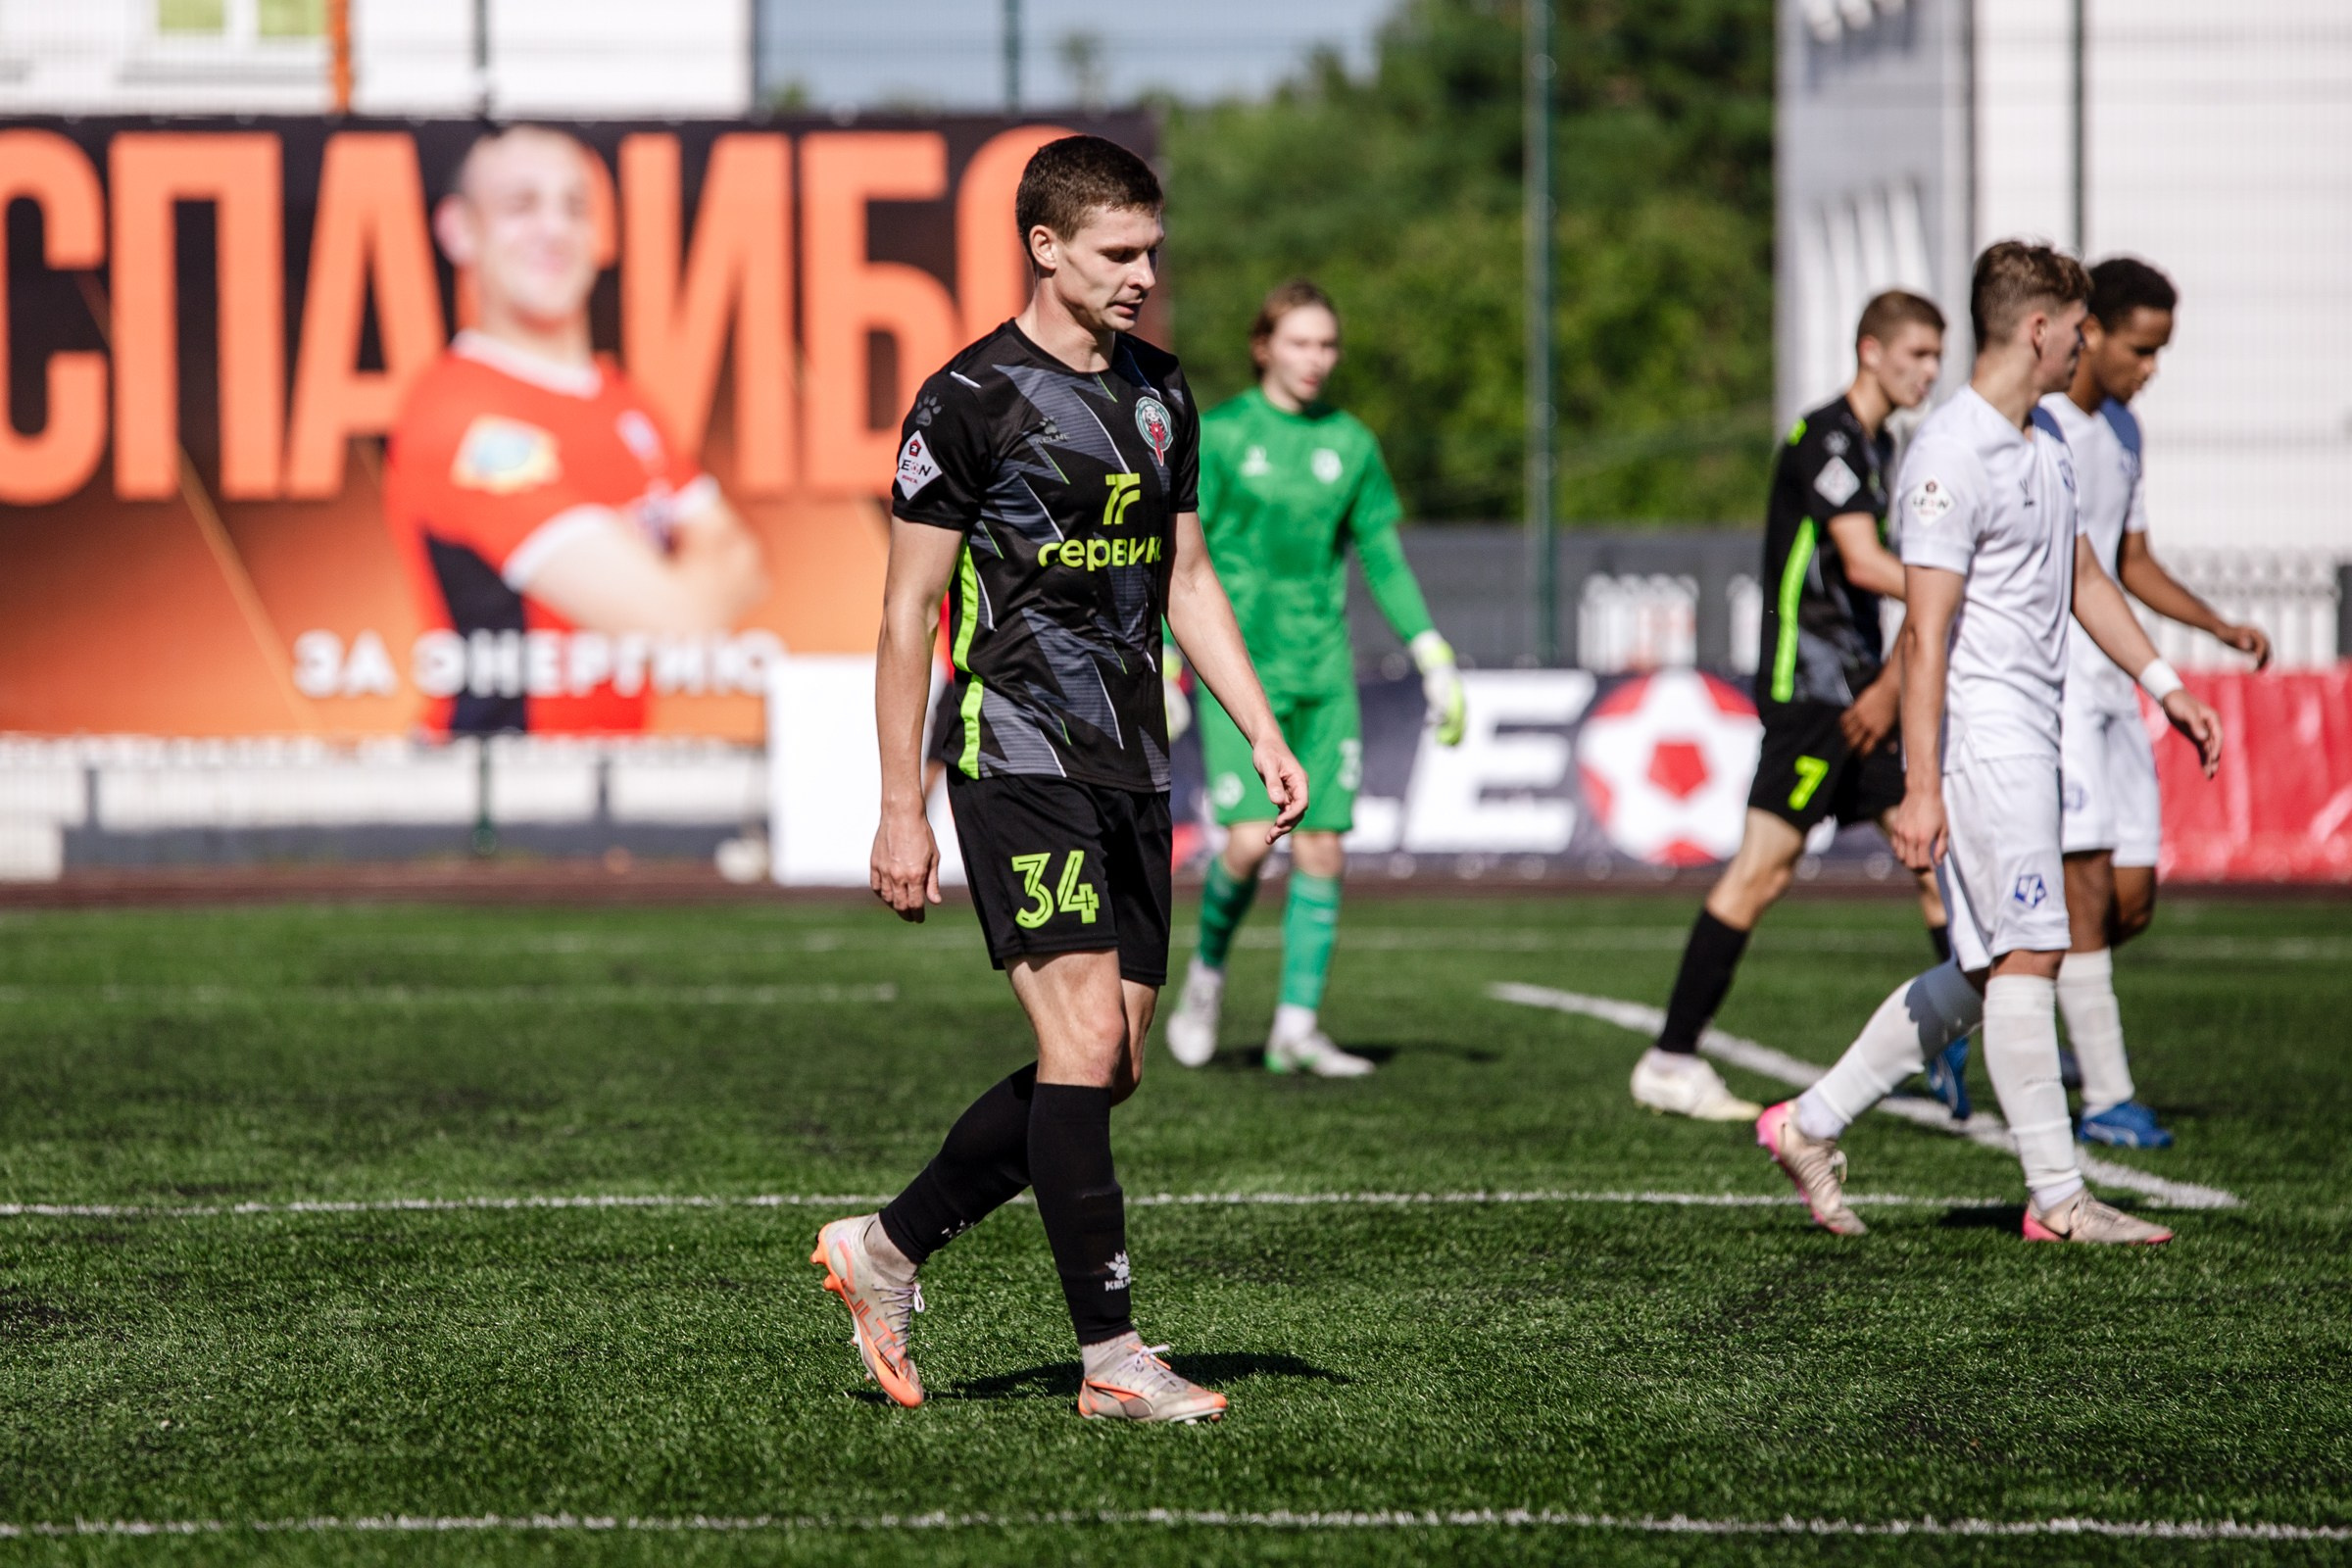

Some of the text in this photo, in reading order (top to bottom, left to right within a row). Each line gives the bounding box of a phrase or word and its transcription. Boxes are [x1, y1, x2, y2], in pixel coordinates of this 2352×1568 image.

[0, 126, 1078, 506] СПАИБ
[294, 628, 787, 699] ЗА ЭНЕРГИЮ
[1788, 755, 1830, 811] 7
[1011, 850, 1100, 929] 34
